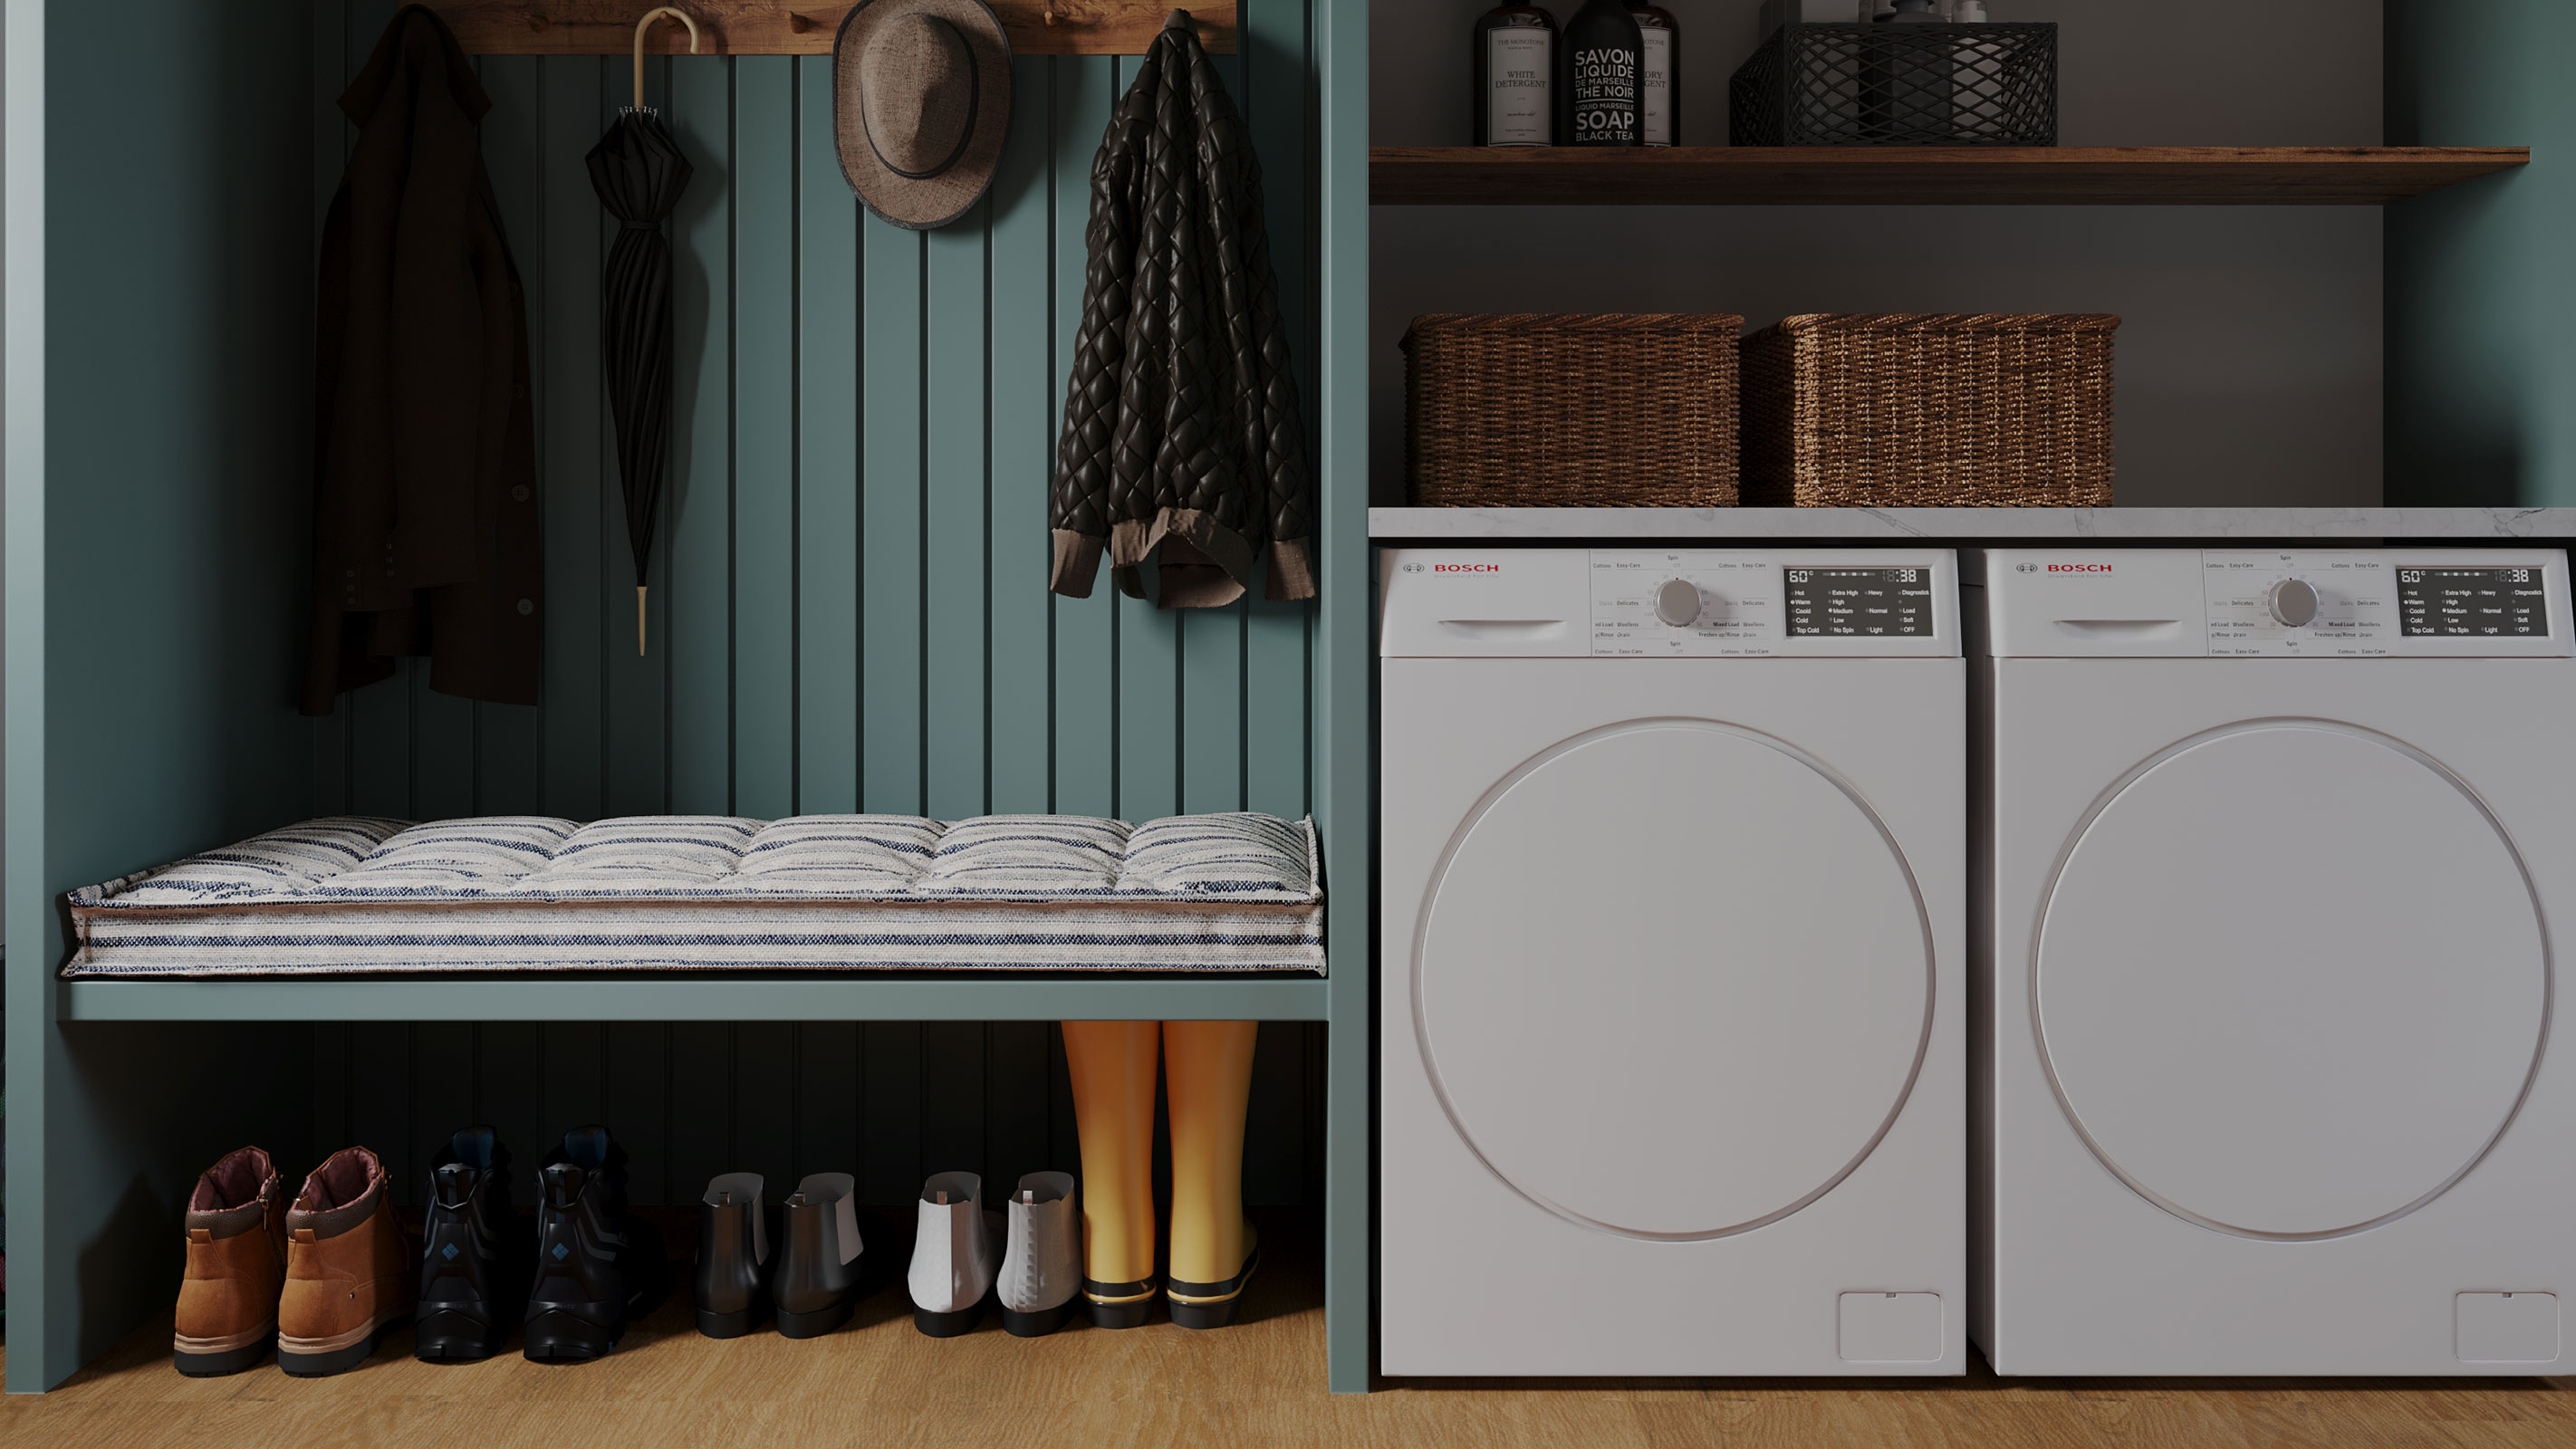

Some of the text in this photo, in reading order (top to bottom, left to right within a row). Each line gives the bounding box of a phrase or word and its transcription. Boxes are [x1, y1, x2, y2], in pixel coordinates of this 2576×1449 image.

[1575, 49, 1634, 65] SAVON
[1575, 64, 1634, 79] LIQUIDE
[1589, 78, 1633, 86] MARSEILLE
[1576, 86, 1634, 99] THE NOIR
[1576, 102, 1633, 111] LIQUID MARSEILLE
[1576, 110, 1634, 130] SOAP
[1576, 131, 1634, 141] BLACK TEA
